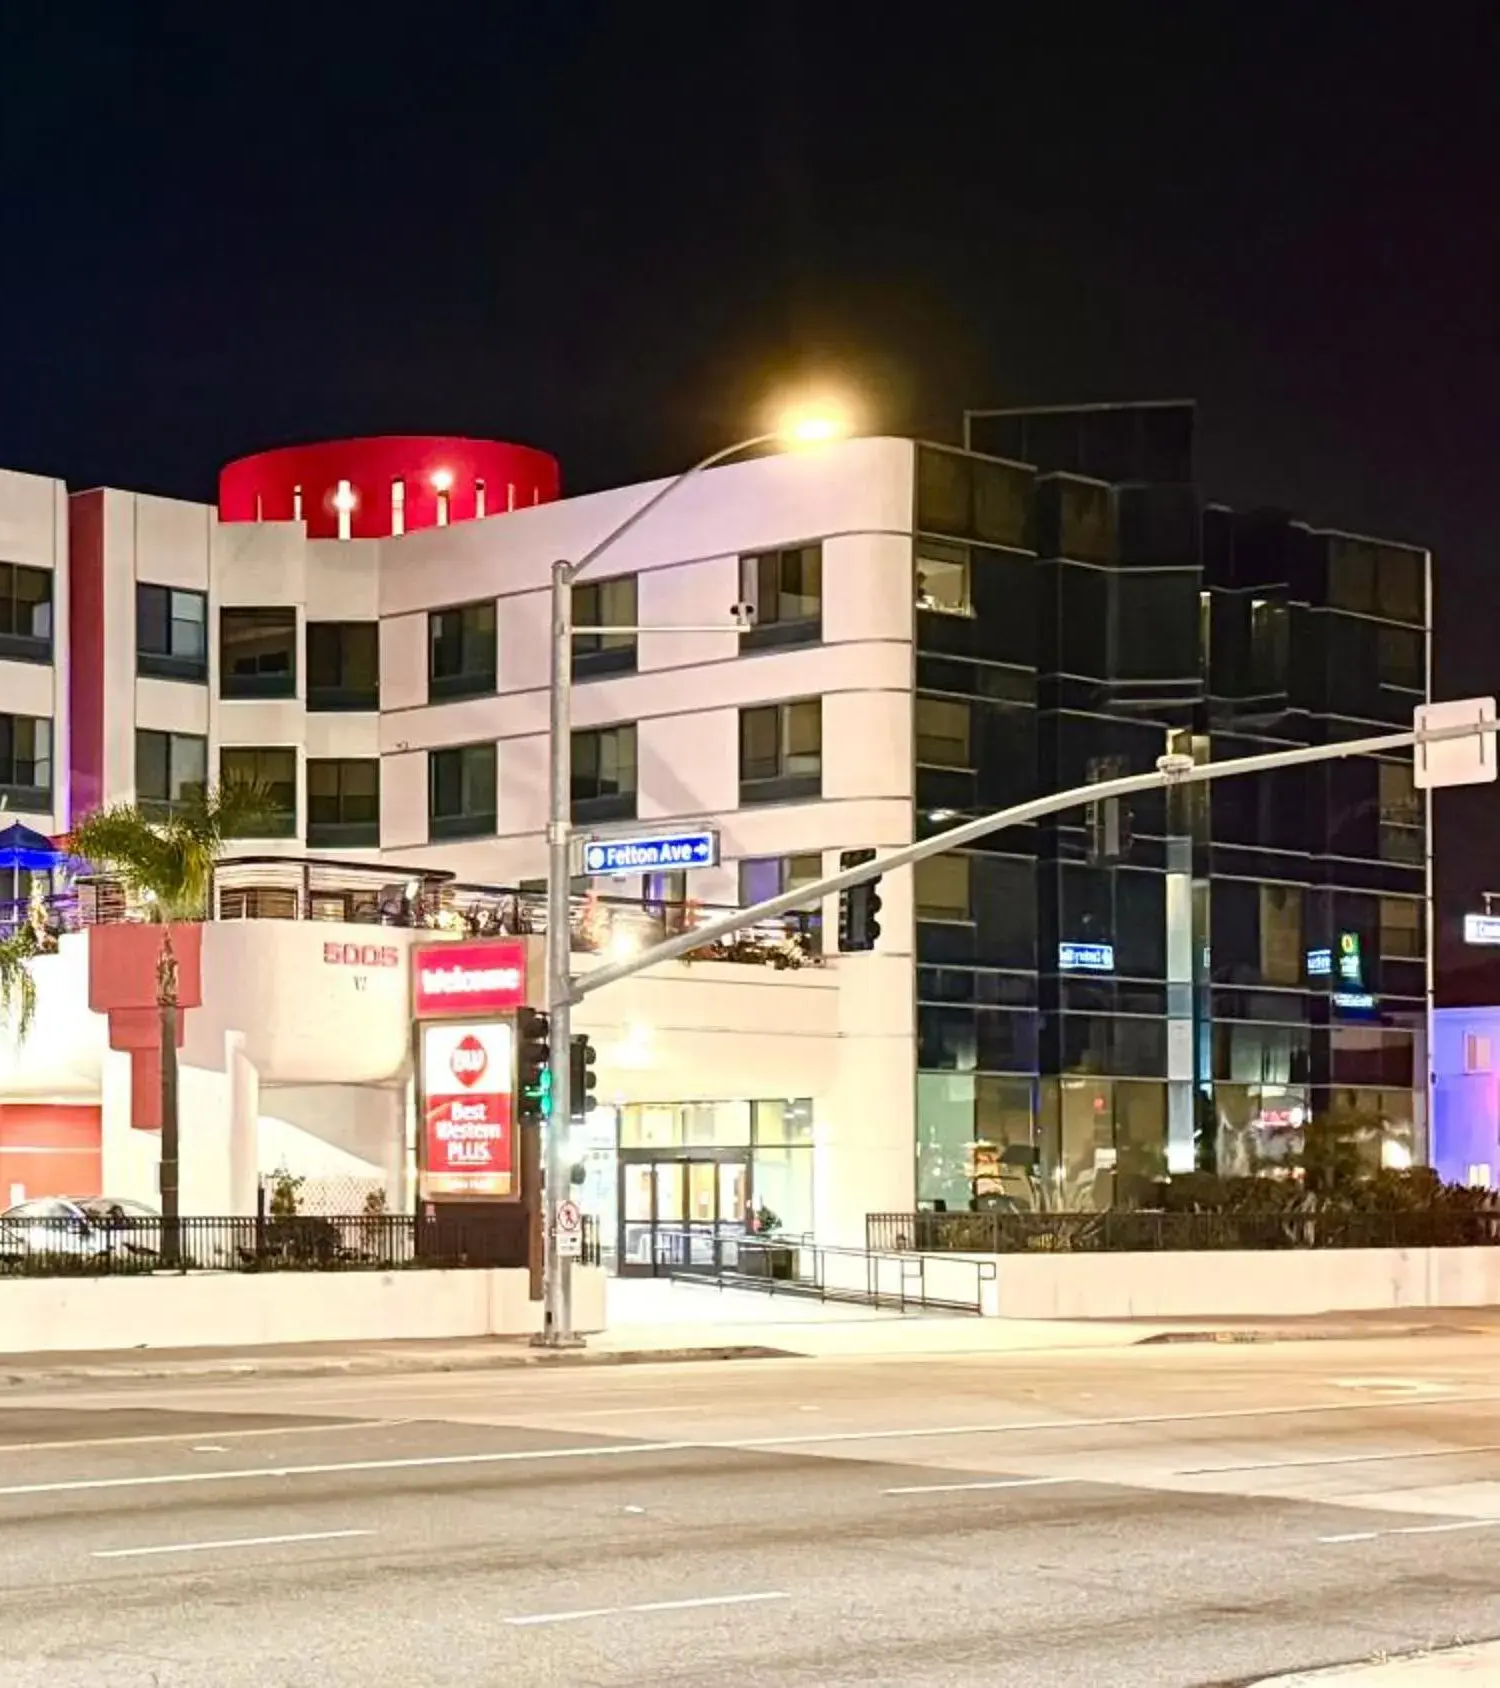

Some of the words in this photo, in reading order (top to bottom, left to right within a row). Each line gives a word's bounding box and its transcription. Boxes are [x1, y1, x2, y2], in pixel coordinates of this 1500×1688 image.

[607, 845, 658, 866] Felton
[660, 842, 692, 862] Ave
[323, 942, 399, 967] 5005
[421, 965, 520, 994] Welcome
[451, 1101, 487, 1121] Best
[435, 1121, 503, 1140] Western
[447, 1140, 493, 1162] PLUS
